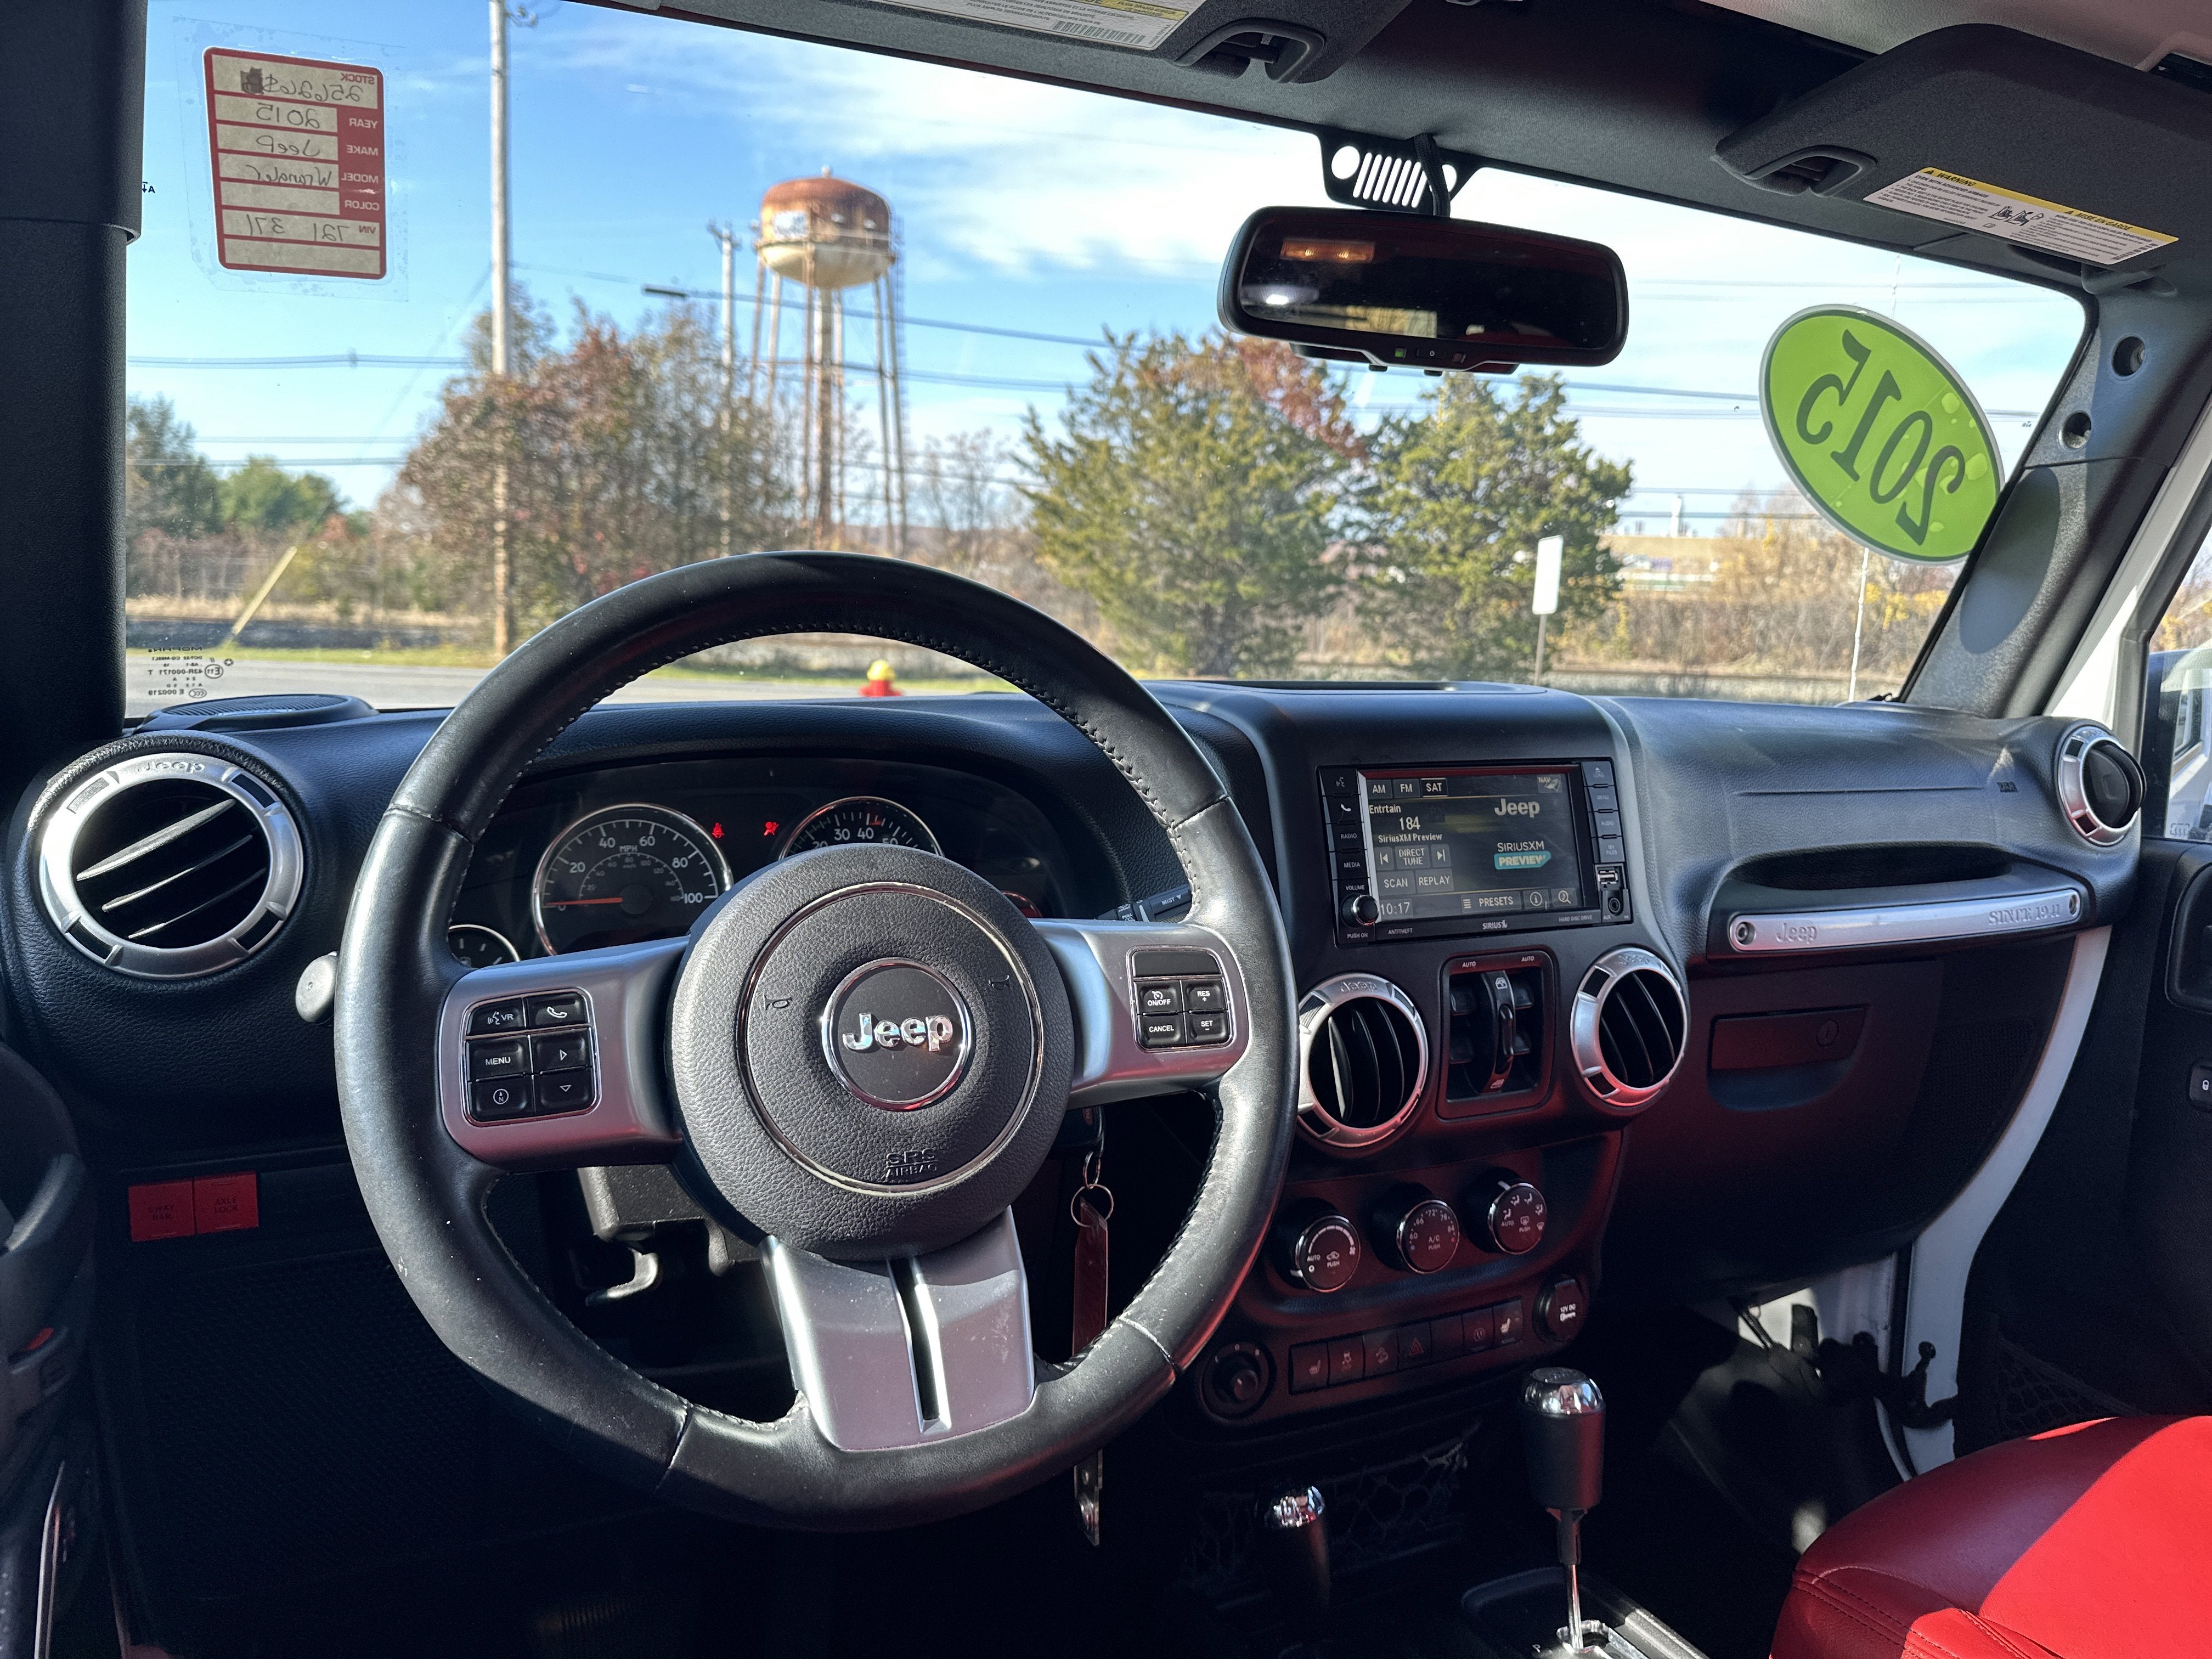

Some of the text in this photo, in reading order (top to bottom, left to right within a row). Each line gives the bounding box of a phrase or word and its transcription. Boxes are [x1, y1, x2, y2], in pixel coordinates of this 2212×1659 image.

[1937, 173, 1977, 187] WARNING
[2075, 213, 2098, 223] MISE
[2106, 220, 2134, 231] GARDE
[137, 761, 205, 774] Jeep
[1372, 784, 1386, 794] AM
[1400, 783, 1413, 793] FM
[1426, 782, 1442, 792] SAT
[1369, 804, 1402, 814] Entrtain
[1494, 798, 1541, 819] Jeep
[1399, 816, 1421, 831] 184
[833, 828, 851, 841] 30
[856, 827, 874, 840] 40
[1378, 832, 1443, 843] SiriusXM Preview
[599, 837, 616, 849] 40
[639, 835, 656, 847] 60
[1497, 840, 1545, 853] SIRIUSXM
[1398, 848, 1425, 857] DIRECT
[672, 857, 689, 868] 80
[1402, 856, 1424, 866] TUNE
[1498, 854, 1546, 867] PREVIEW
[569, 862, 586, 873] 20
[1384, 878, 1408, 888] SCAN
[1418, 876, 1450, 887] REPLAY
[684, 891, 704, 904] 100
[1479, 896, 1514, 907] PRESETS
[1380, 901, 1410, 916] 10:17
[1988, 908, 2032, 926] SINCE
[1482, 921, 1502, 930] SIRIUS
[1776, 922, 1818, 944] Jeep
[1341, 980, 1378, 994] Jeep
[1197, 990, 1210, 998] RES
[1147, 998, 1171, 1007] ON/OFF
[842, 1011, 955, 1053] Jeep
[1149, 1024, 1175, 1033] CANCEL
[485, 1056, 511, 1066] MENU
[885, 1148, 935, 1164] SRS
[885, 1164, 937, 1178] AIRBAG
[1307, 1254, 1321, 1262] AUTO
[1327, 1260, 1340, 1268] PUSH
[1532, 1644, 1541, 1653] P
